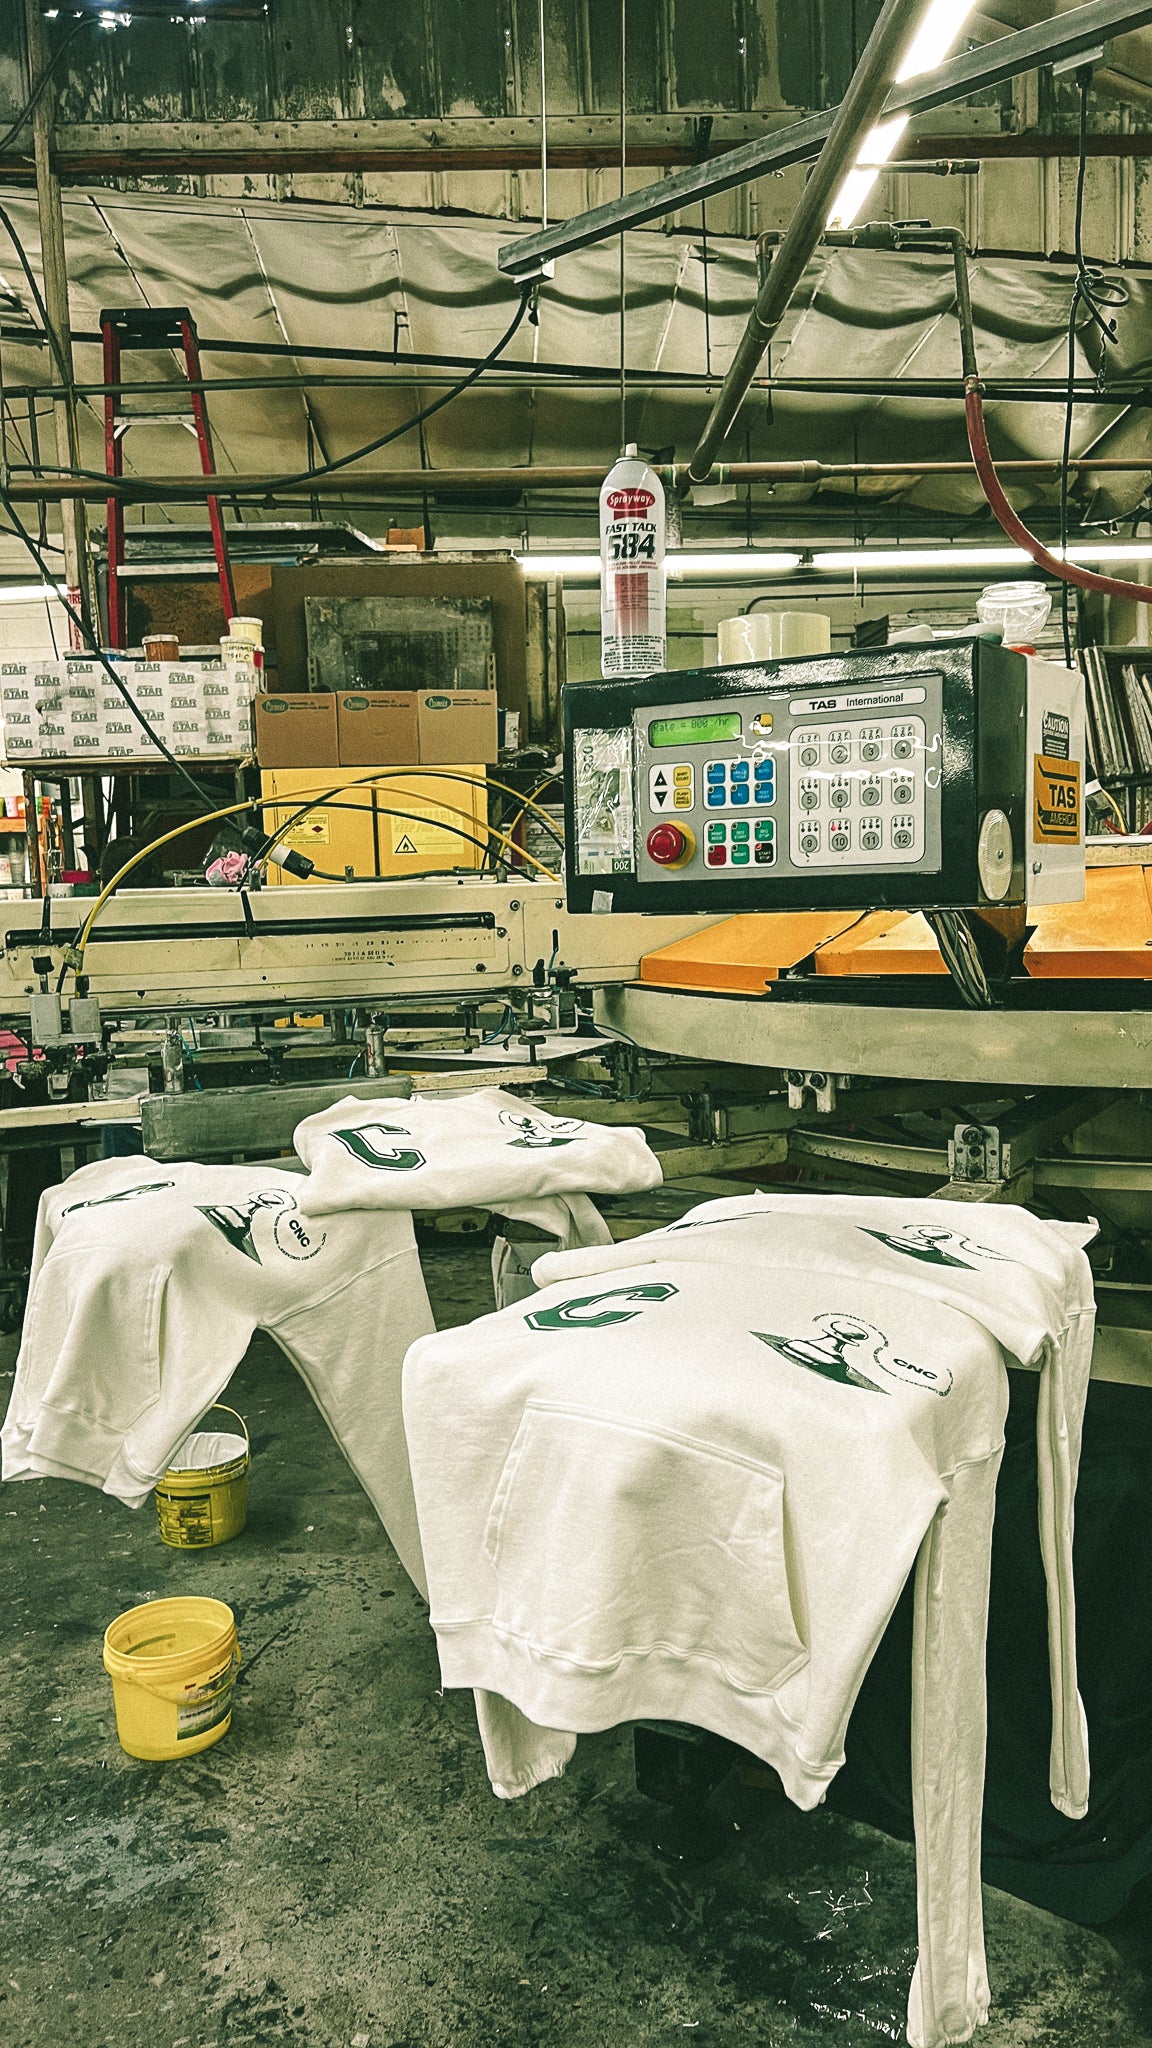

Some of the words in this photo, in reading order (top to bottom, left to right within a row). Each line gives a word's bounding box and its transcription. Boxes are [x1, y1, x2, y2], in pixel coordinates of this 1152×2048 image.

[610, 494, 651, 507] Sprayway
[606, 523, 629, 535] FAST
[632, 522, 657, 532] TACK
[608, 533, 655, 560] 584
[809, 700, 837, 711] TAS
[846, 692, 904, 707] International
[653, 723, 675, 732] Rate
[807, 753, 811, 761] 1
[837, 750, 843, 759] 2
[868, 748, 874, 756] 3
[837, 794, 843, 803] 6
[868, 792, 874, 801] 7
[900, 789, 906, 799] 8
[1049, 784, 1076, 808] TAS
[806, 796, 812, 805] 5
[1050, 812, 1076, 825] AMERICA
[807, 839, 812, 848] 9
[835, 837, 845, 847] 10
[866, 836, 876, 845] 11
[897, 835, 908, 844] 12
[613, 861, 629, 870] 200
[328, 1123, 427, 1171] C
[289, 1220, 310, 1247] CNC
[523, 1283, 680, 1331] C
[893, 1358, 938, 1380] CNC
